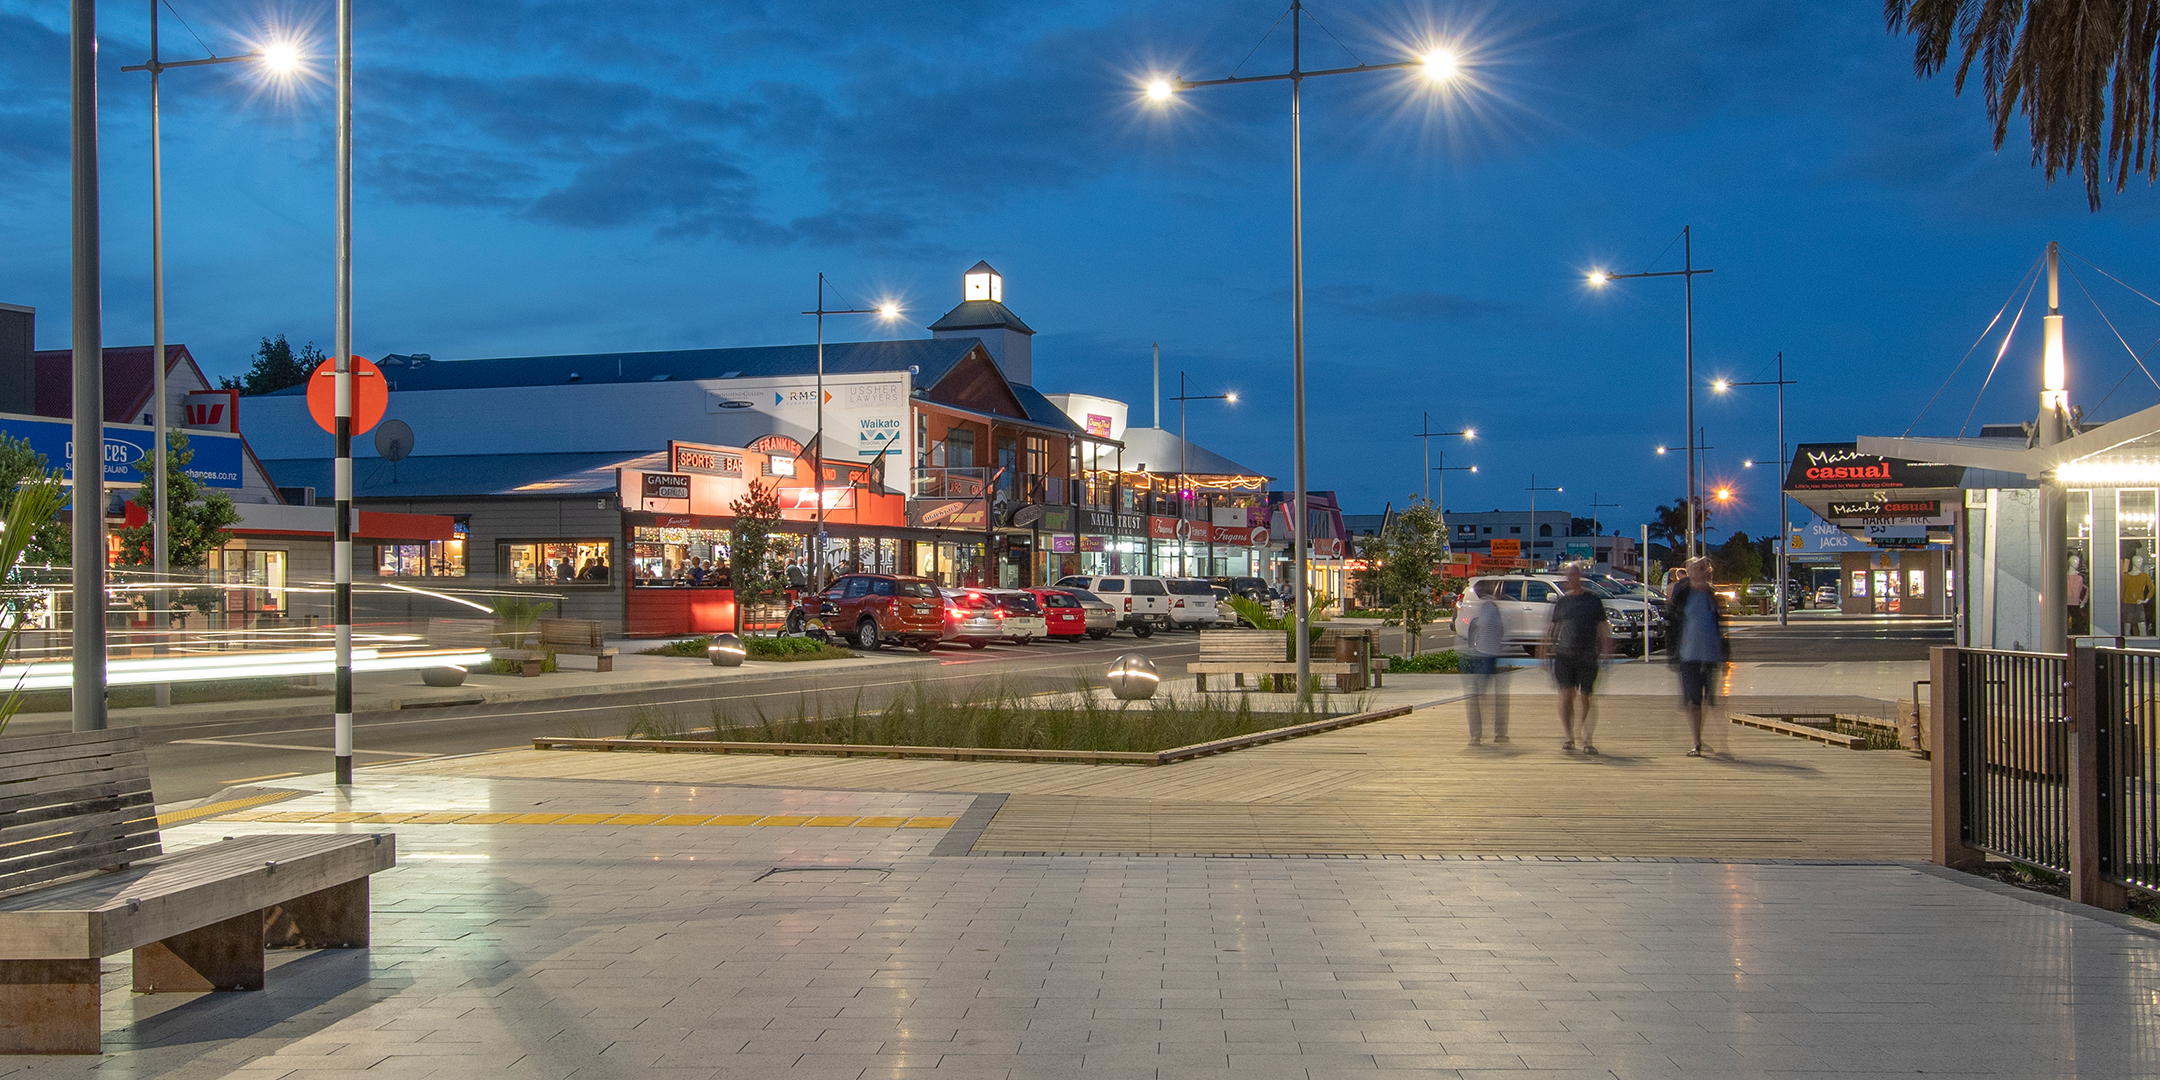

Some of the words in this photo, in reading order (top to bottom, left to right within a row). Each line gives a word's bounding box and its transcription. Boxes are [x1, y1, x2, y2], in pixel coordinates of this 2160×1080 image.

[789, 390, 817, 401] RMS
[850, 384, 898, 396] USSHER
[849, 393, 898, 403] LAWYERS
[860, 419, 900, 428] Waikato
[758, 437, 802, 456] FRANKIES
[680, 452, 715, 469] SPORTS
[726, 457, 743, 472] BAR
[1806, 462, 1892, 479] casual
[647, 475, 688, 486] GAMING
[1833, 501, 1881, 514] Mainly
[1884, 501, 1934, 512] casual
[1090, 513, 1115, 527] NATAL
[1117, 515, 1141, 529] TRUST
[1212, 527, 1248, 544] Fagans
[1819, 537, 1848, 550] JACKS
